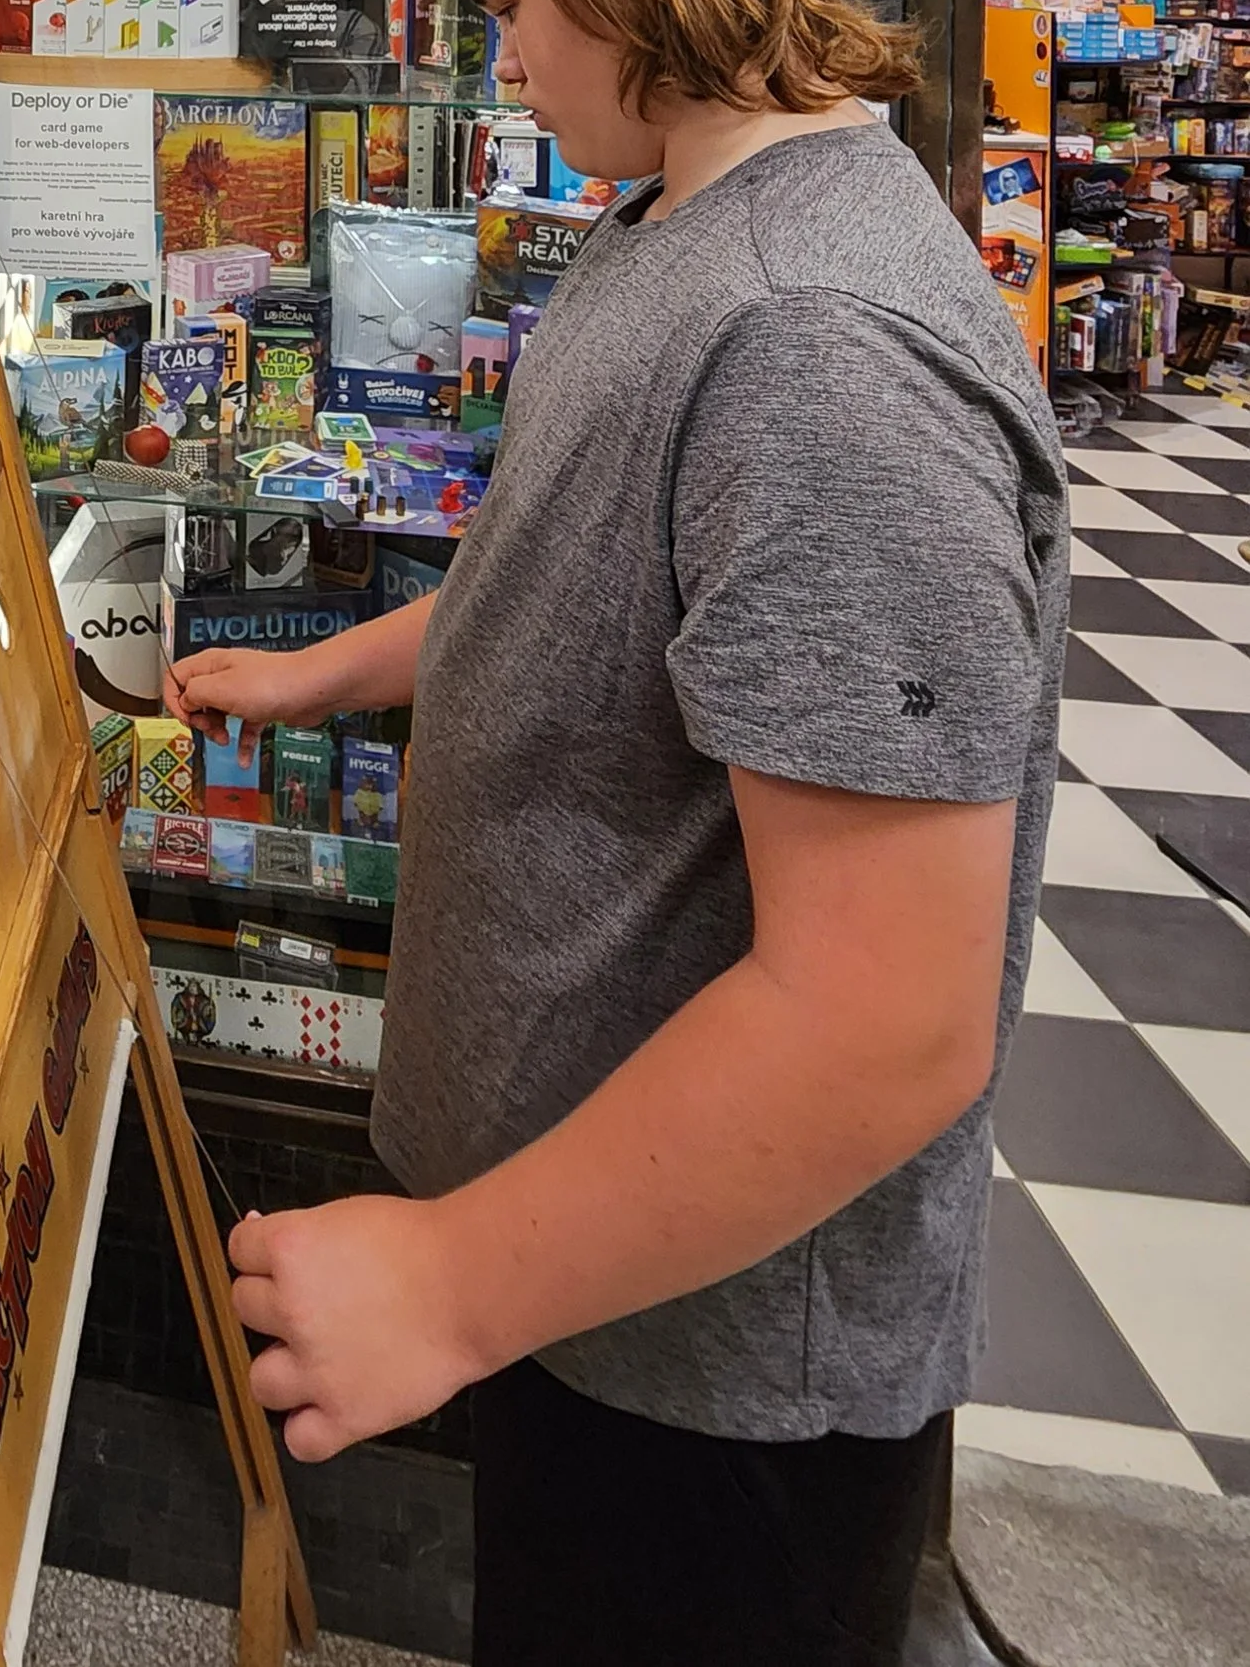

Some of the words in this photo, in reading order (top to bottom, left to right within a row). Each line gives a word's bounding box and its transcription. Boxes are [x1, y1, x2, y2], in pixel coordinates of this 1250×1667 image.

[258, 23, 283, 32] about
[284, 21, 307, 31] game
[308, 23, 328, 32] card
[11, 92, 71, 112] Deploy
[76, 96, 94, 109] or
[162, 99, 280, 130] BARCELONA
[41, 122, 67, 133] card
[70, 123, 103, 135] game
[15, 138, 31, 148] for
[34, 138, 130, 152] web-developers
[40, 210, 82, 222] karetní
[85, 211, 105, 222] hra
[11, 227, 31, 239] pro
[34, 226, 81, 239] webové
[83, 228, 135, 242] vývojáře
[264, 311, 314, 323] LORCANA
[158, 346, 215, 370] KABO
[267, 350, 296, 364] KDO
[261, 365, 276, 377] TO
[38, 366, 108, 394] ALPINA
[189, 609, 357, 644] EVOLUTION
[281, 751, 322, 764] FOREST
[349, 756, 390, 774] HYGGE
[163, 818, 206, 836] BICYCLE
